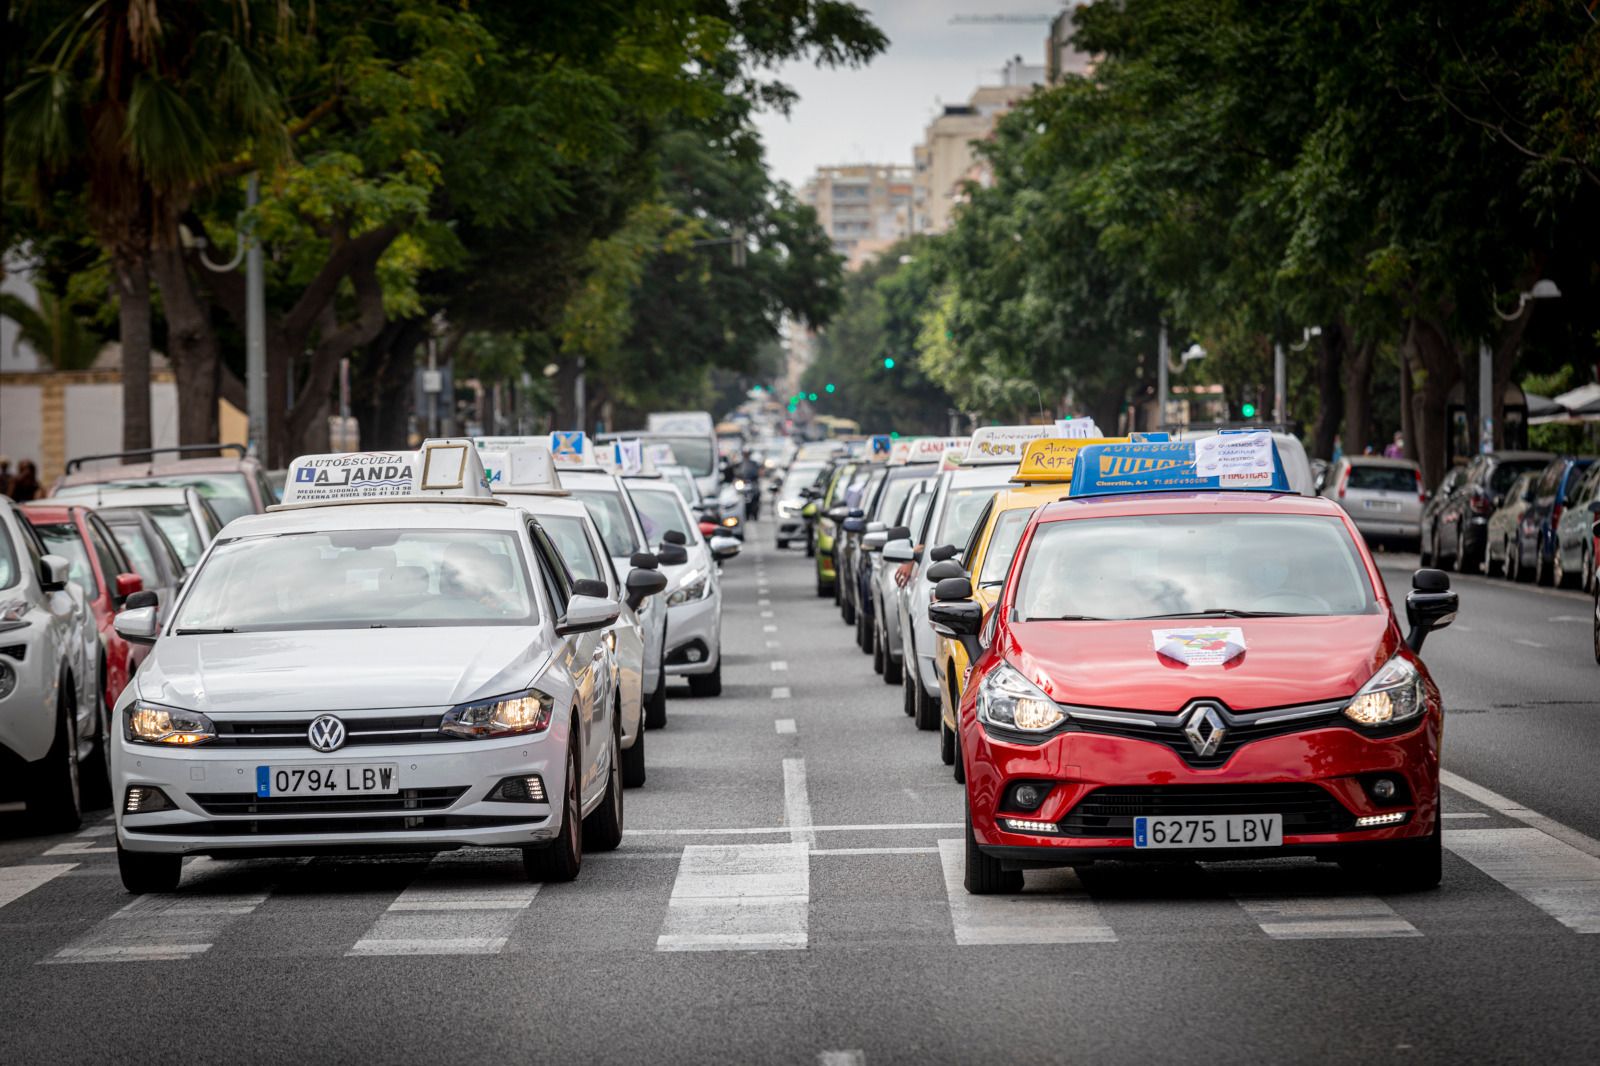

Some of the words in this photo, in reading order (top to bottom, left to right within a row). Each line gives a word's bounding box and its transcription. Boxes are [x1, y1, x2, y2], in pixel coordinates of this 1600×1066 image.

[304, 456, 403, 468] AUTOESCUELA
[315, 465, 413, 486] JANDA
[275, 769, 337, 792] 0794
[346, 767, 393, 790] LBW
[1152, 820, 1216, 844] 6275
[1226, 818, 1273, 843] LBV
